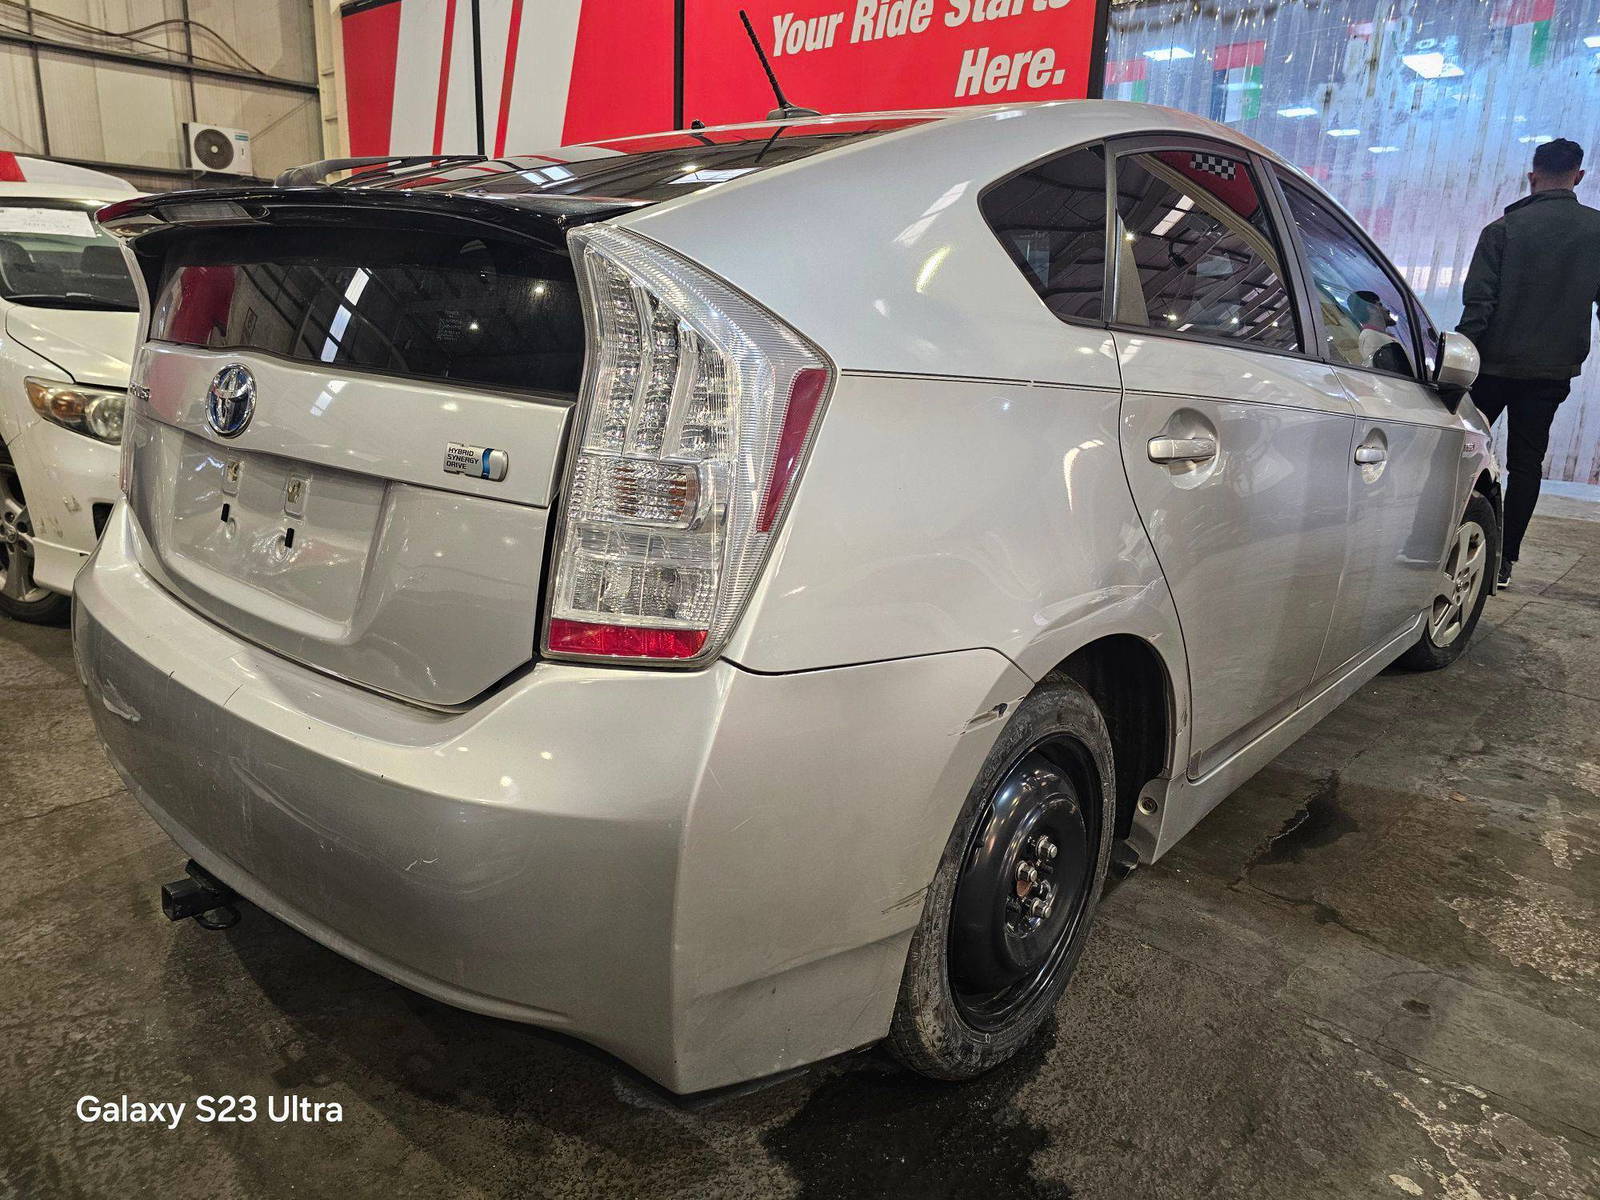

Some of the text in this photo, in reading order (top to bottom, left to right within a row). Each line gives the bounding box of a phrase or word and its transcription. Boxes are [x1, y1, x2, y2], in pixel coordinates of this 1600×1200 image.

[772, 12, 844, 57] Your
[849, 0, 934, 44] Ride
[954, 47, 1065, 98] Here.
[448, 447, 474, 457] HYBRID
[446, 460, 467, 470] DRIVE
[447, 453, 479, 465] SYNERGY
